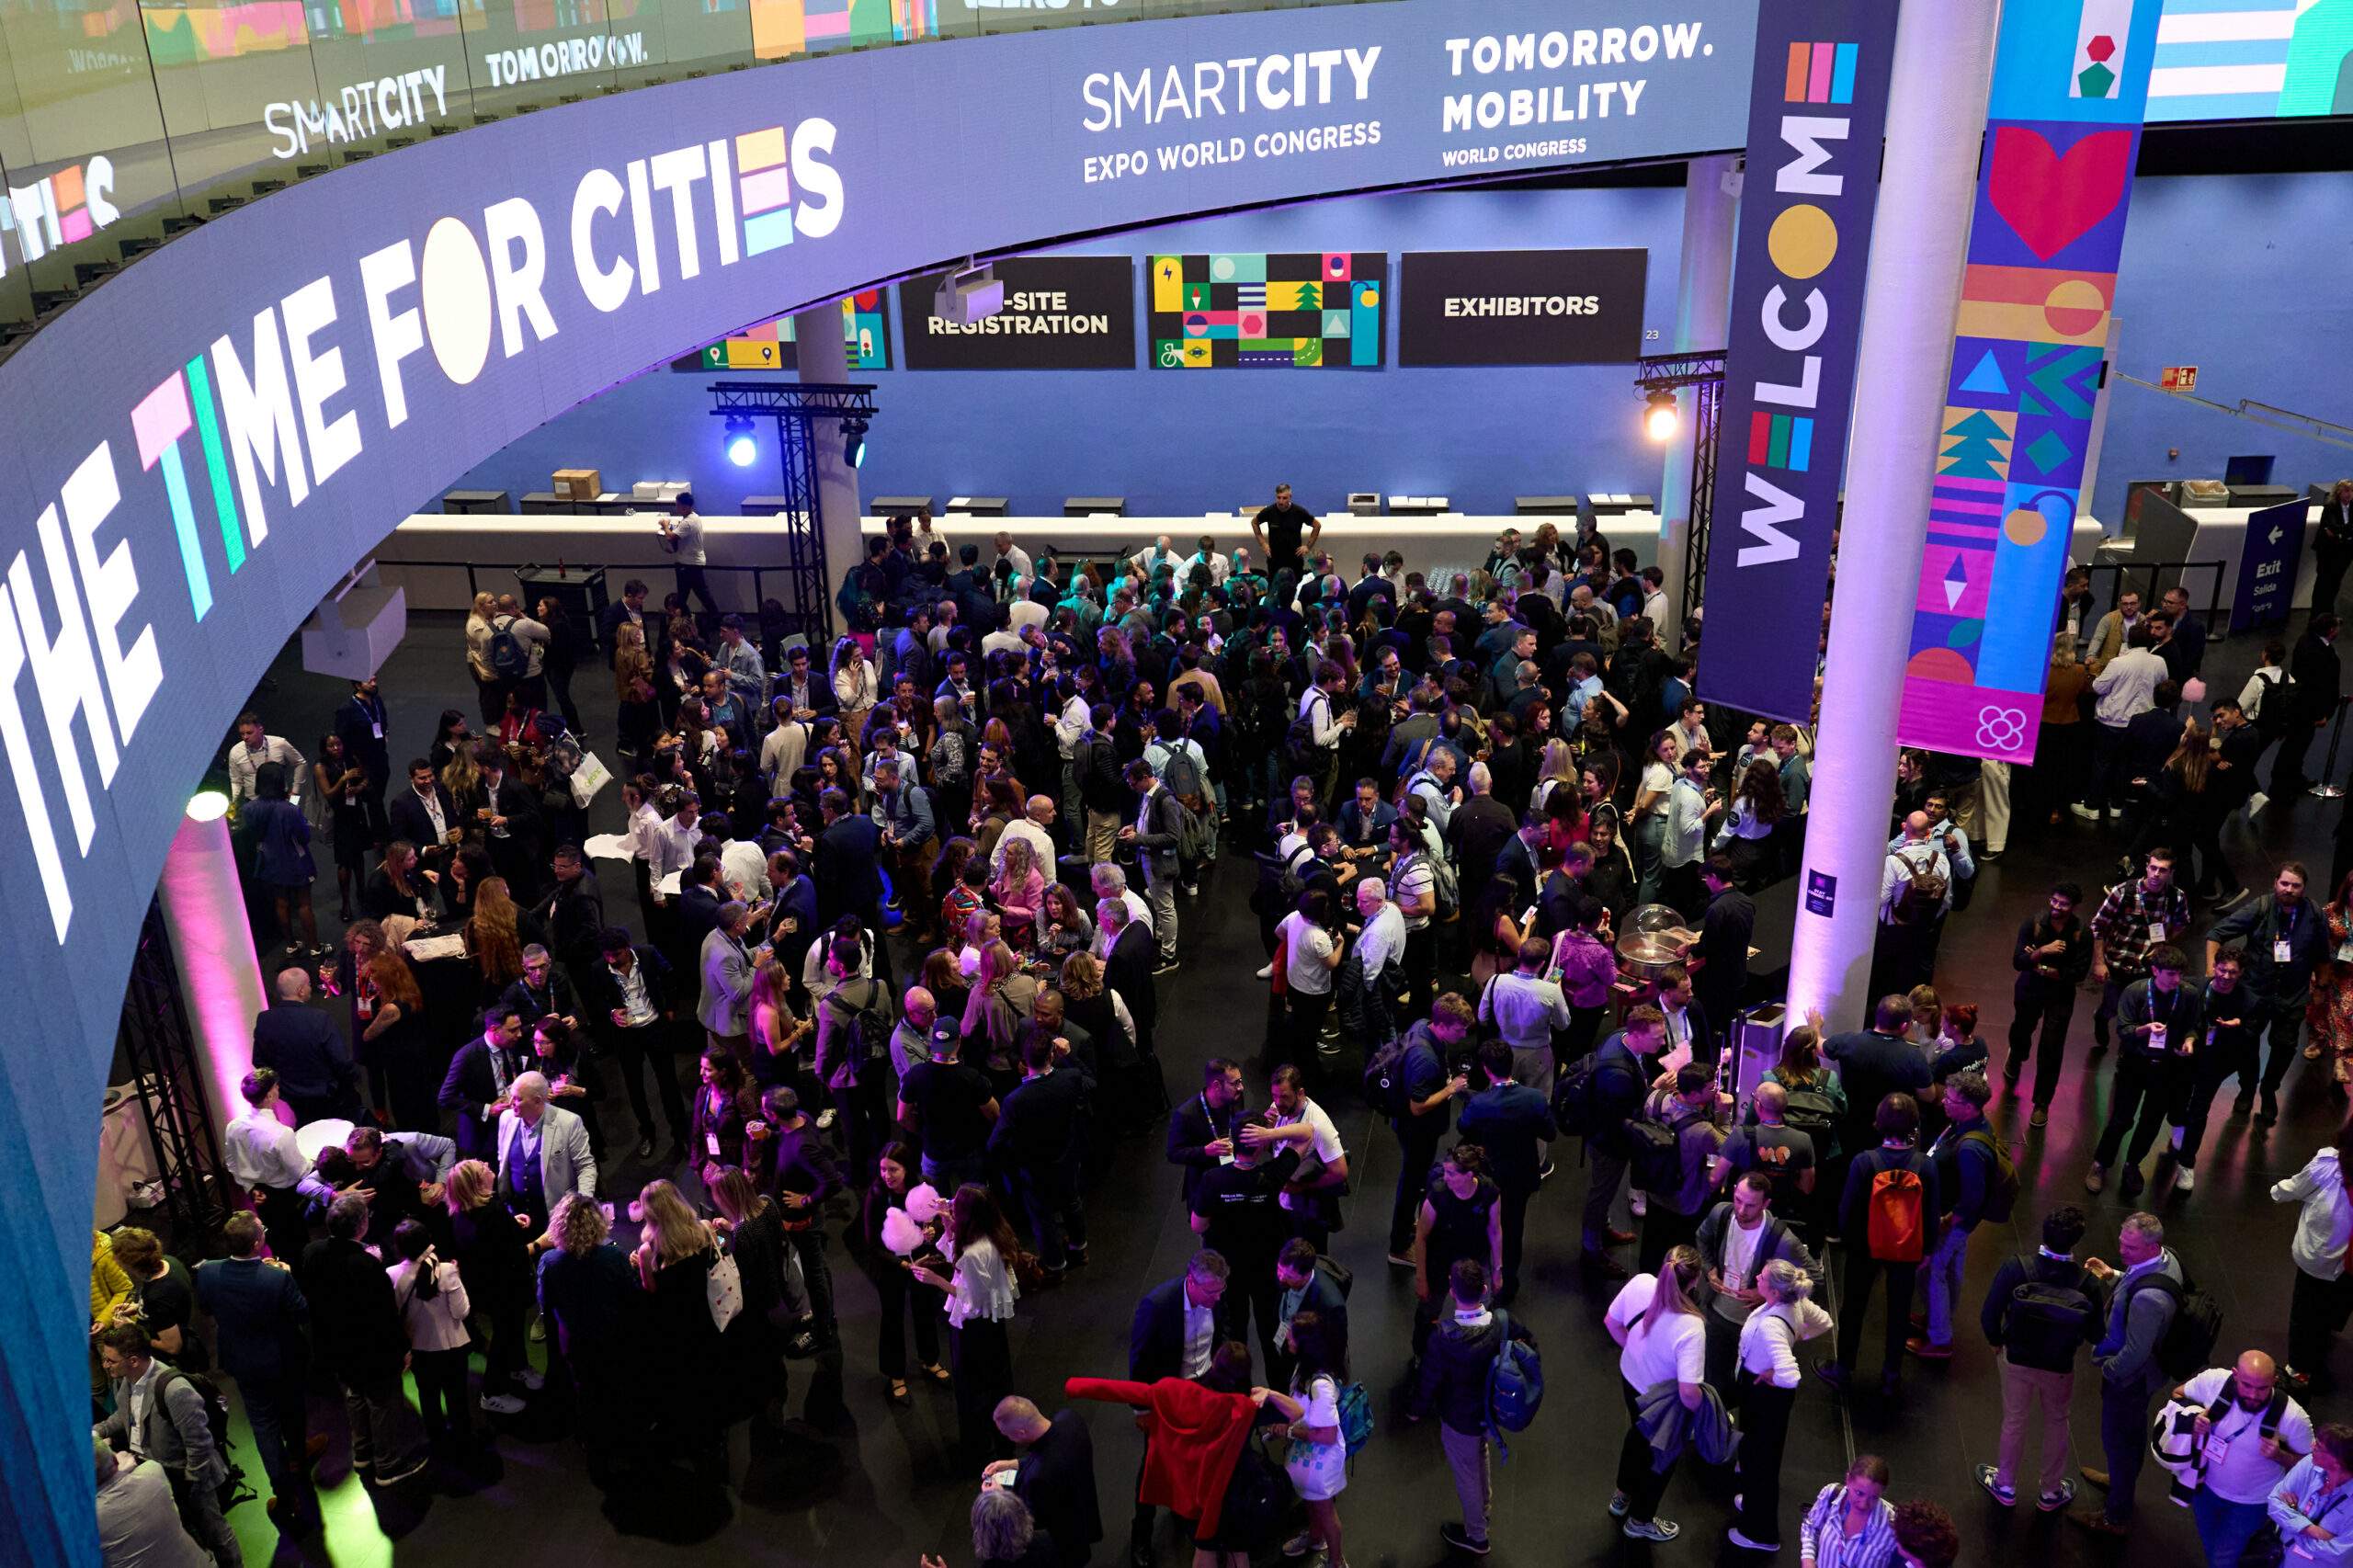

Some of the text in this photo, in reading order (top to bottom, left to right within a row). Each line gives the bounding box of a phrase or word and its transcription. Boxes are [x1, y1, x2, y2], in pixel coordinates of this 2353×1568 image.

[1445, 22, 1713, 75] TOMORROW.
[1083, 46, 1382, 131] SMARTCITY
[1442, 79, 1647, 132] MOBILITY
[1084, 120, 1381, 183] EXPO WORLD CONGRESS
[1442, 138, 1587, 167] WORLD CONGRESS
[1004, 291, 1067, 311] -SITE
[1444, 295, 1599, 317] EXHIBITORS
[1736, 42, 1859, 568] WELCOME
[927, 315, 1108, 335] REGISTRATION
[1645, 330, 1659, 340] 23
[131, 276, 363, 622] TIME
[359, 197, 559, 429] FOR
[571, 117, 845, 312] CITIES
[2256, 560, 2281, 579] Exit
